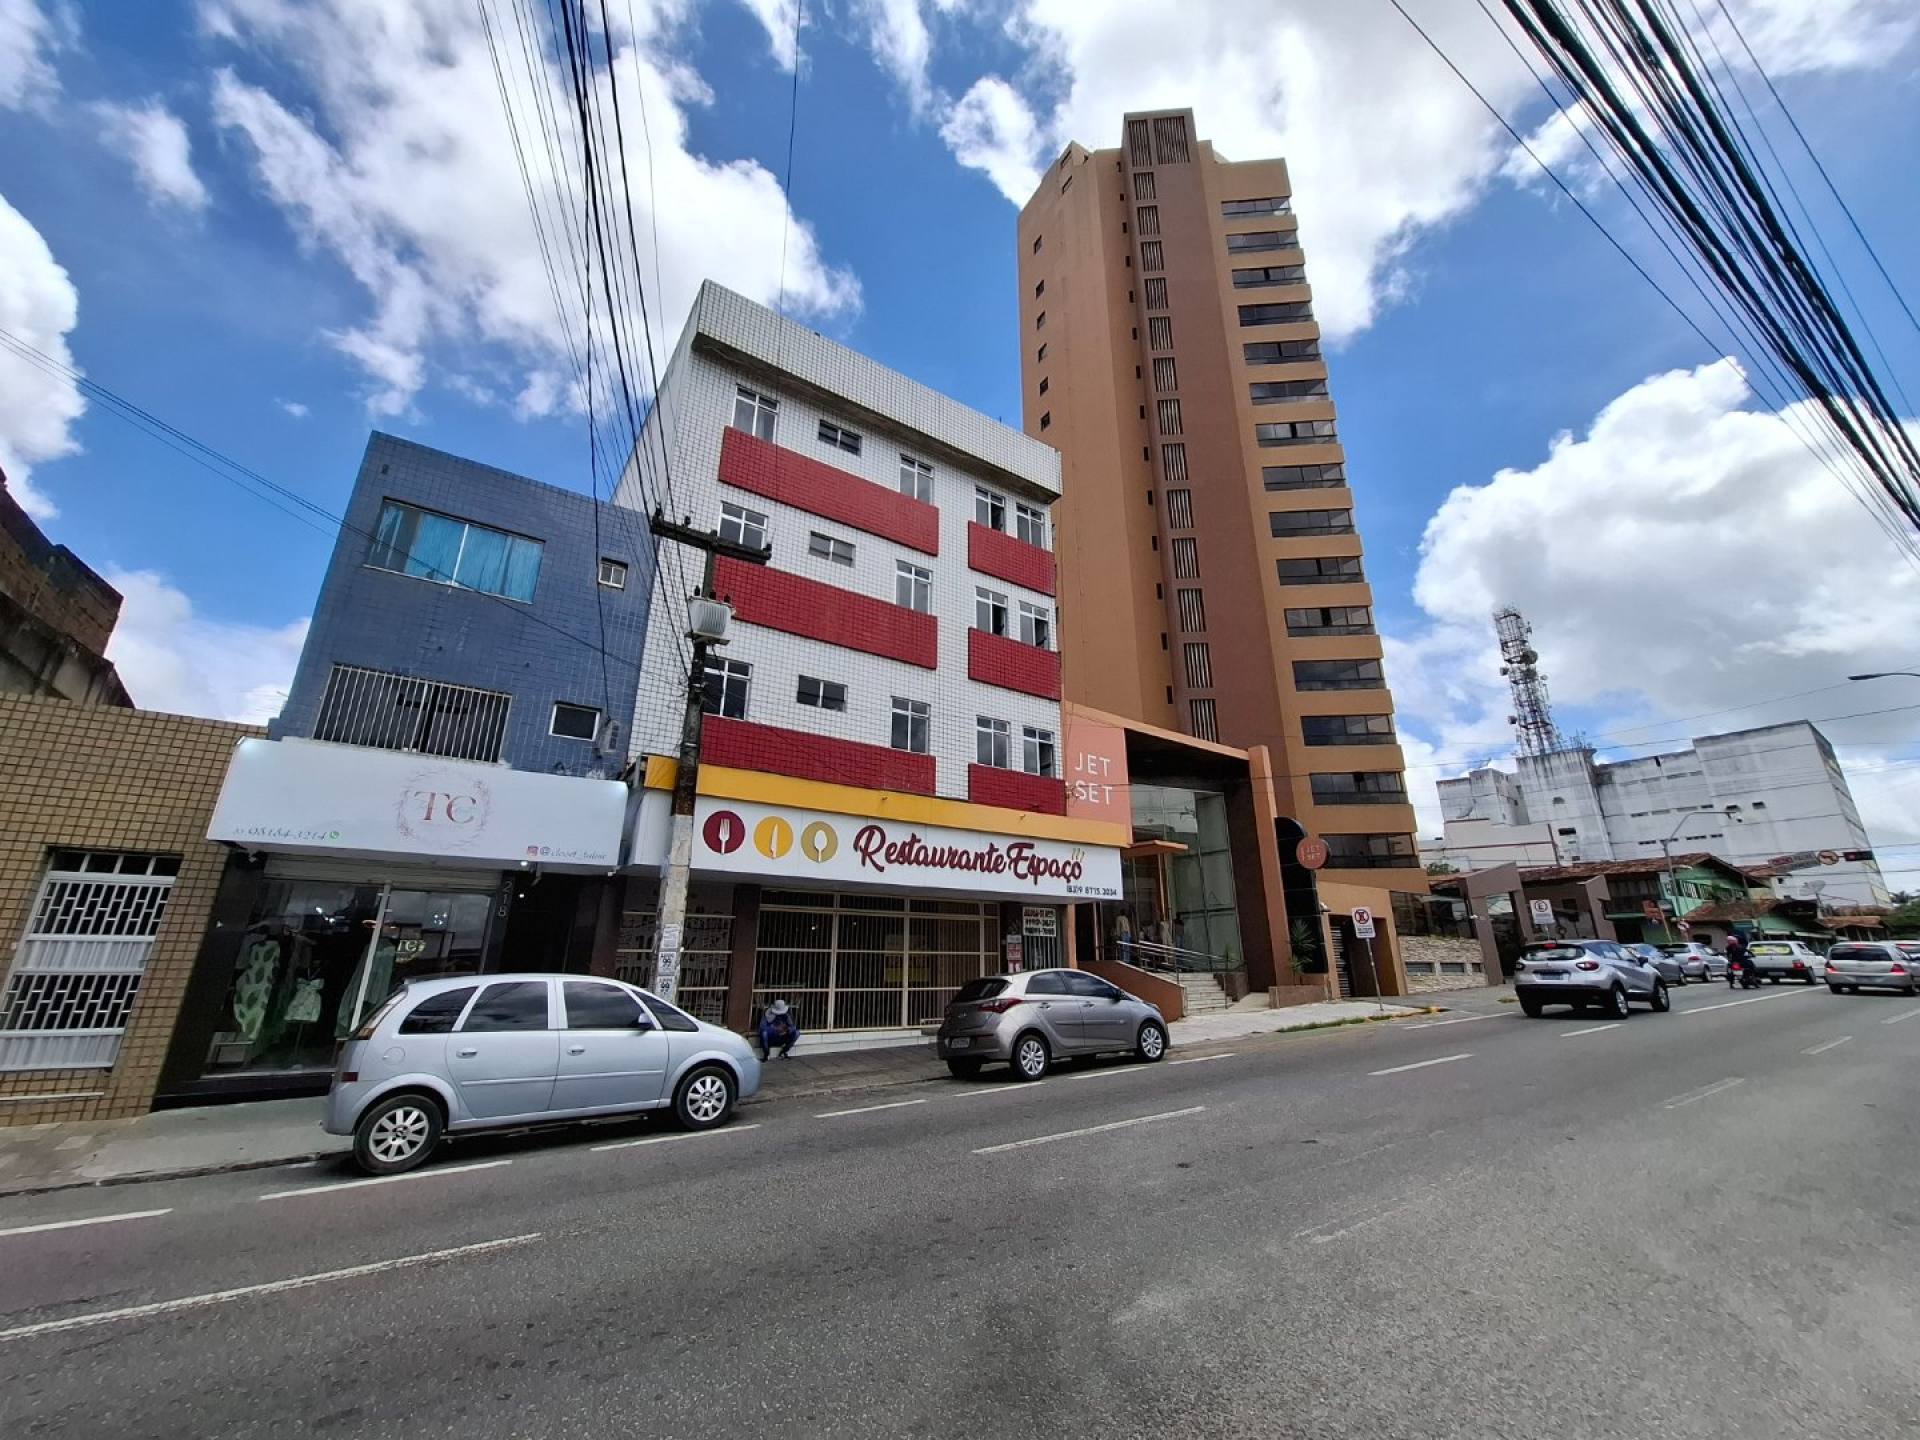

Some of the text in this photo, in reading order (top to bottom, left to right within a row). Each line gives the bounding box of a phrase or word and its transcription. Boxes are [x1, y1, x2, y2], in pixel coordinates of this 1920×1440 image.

[1075, 752, 1110, 777] JET
[414, 791, 477, 824] TC
[1075, 780, 1113, 805] SET
[853, 824, 1082, 885] Restaurante Espaço
[498, 881, 512, 917] 218
